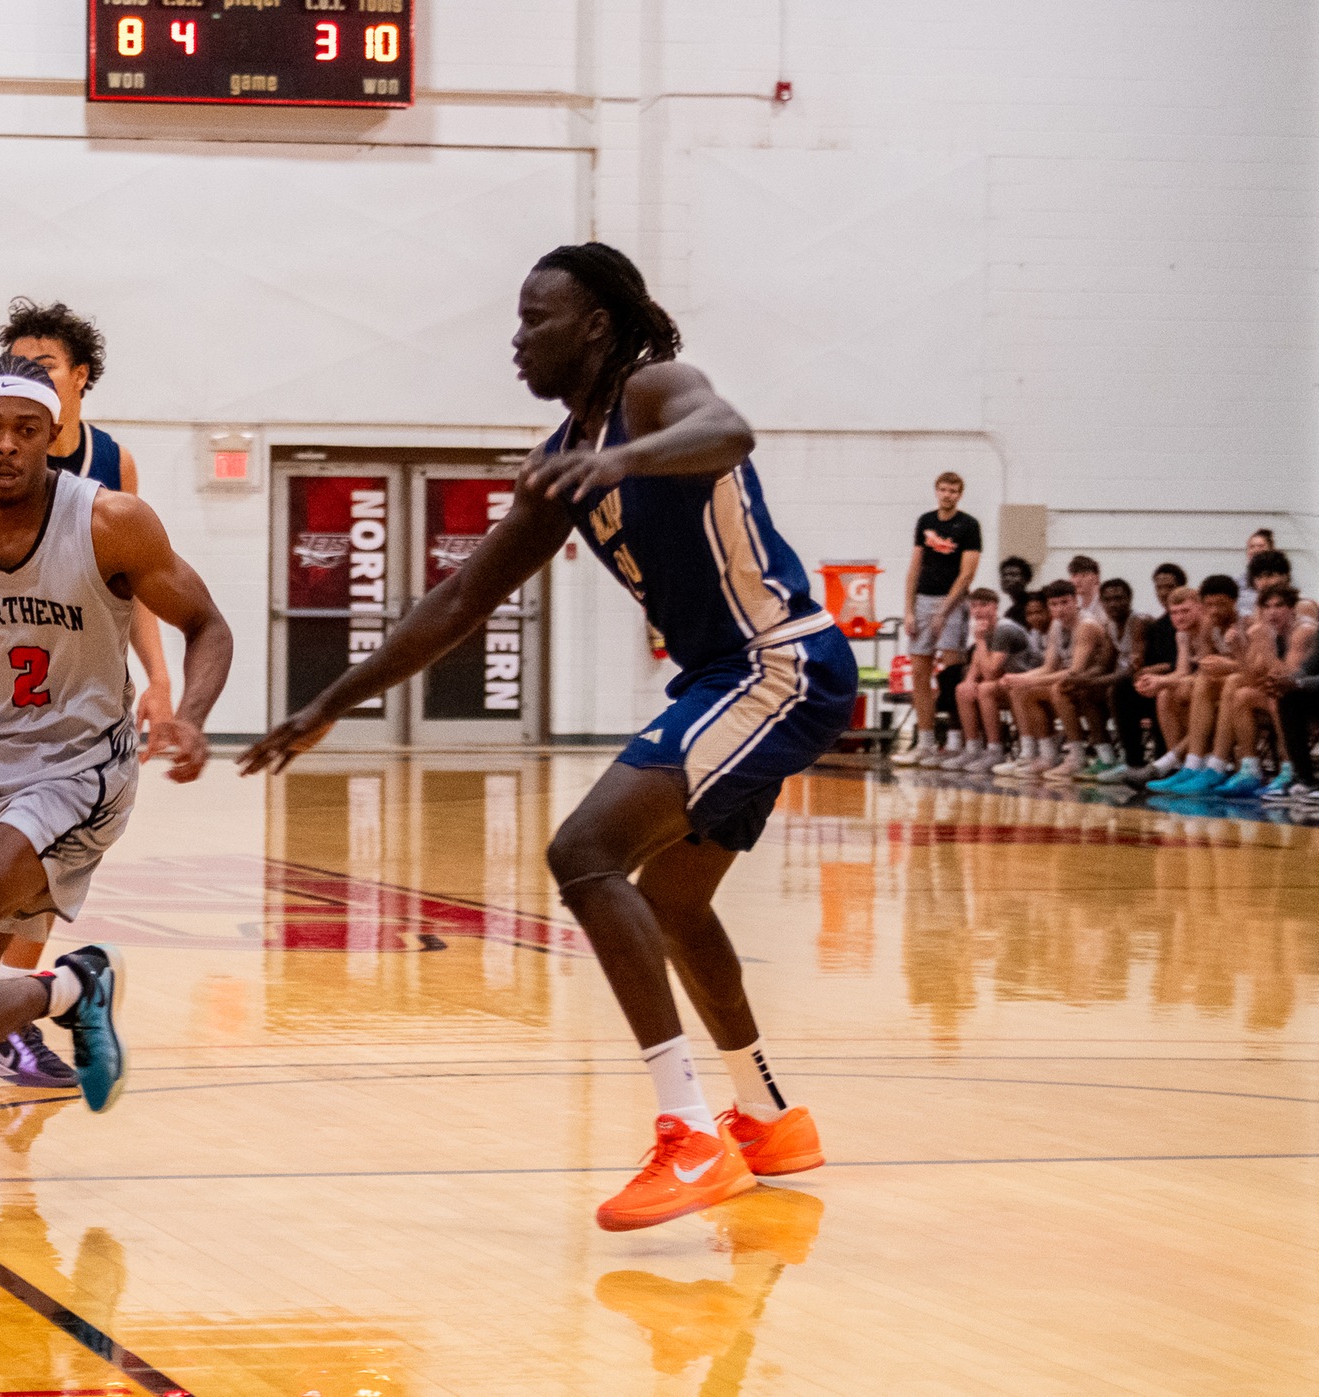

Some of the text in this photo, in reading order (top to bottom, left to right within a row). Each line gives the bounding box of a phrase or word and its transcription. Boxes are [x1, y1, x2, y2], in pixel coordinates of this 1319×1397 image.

[118, 17, 399, 62] 8 4 3 10
[108, 73, 400, 95] won game won
[8, 645, 51, 708] 2
